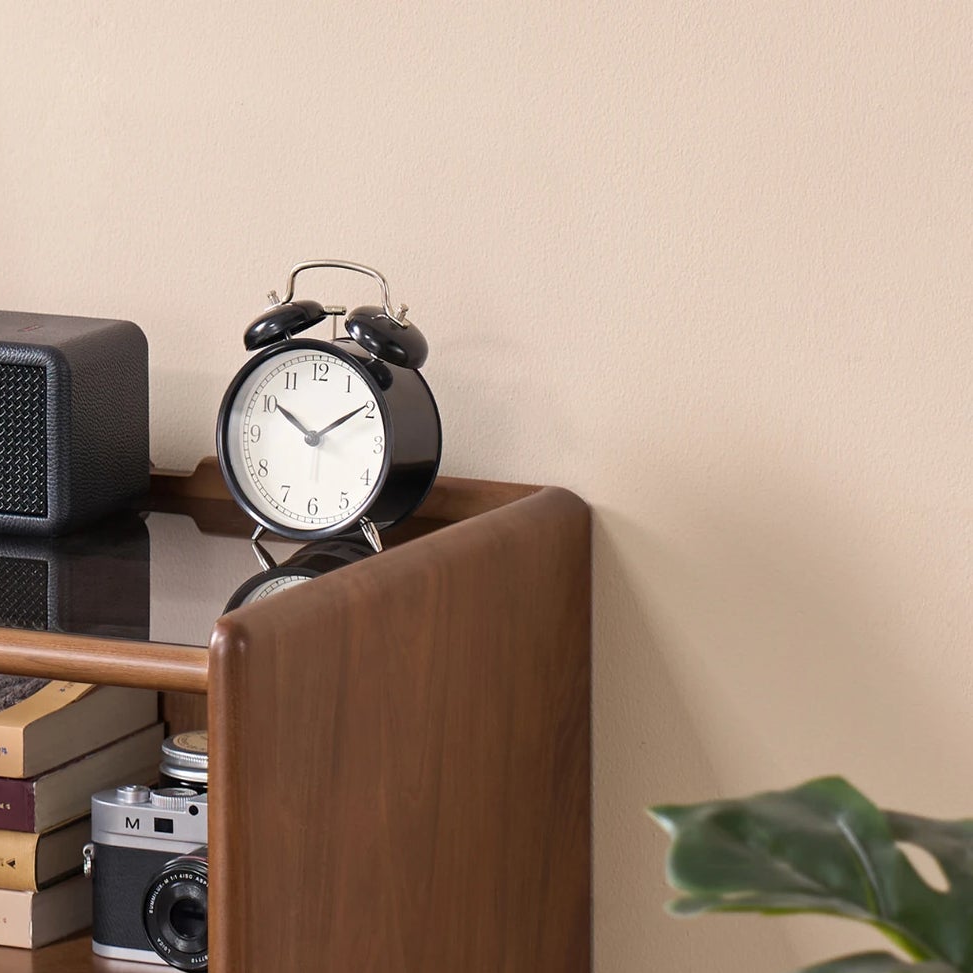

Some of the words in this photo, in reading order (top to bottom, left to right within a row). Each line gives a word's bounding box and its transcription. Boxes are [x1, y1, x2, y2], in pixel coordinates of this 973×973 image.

[284, 372, 298, 390] 11
[312, 362, 329, 382] 12
[345, 375, 352, 393] 1
[263, 394, 278, 413] 10
[365, 400, 376, 419] 2
[250, 424, 261, 443] 9
[373, 436, 383, 454] 3
[258, 458, 269, 477] 8
[360, 468, 372, 486] 4
[280, 484, 291, 503] 7
[339, 491, 349, 510] 5
[307, 497, 318, 516] 6
[125, 816, 140, 830] M
